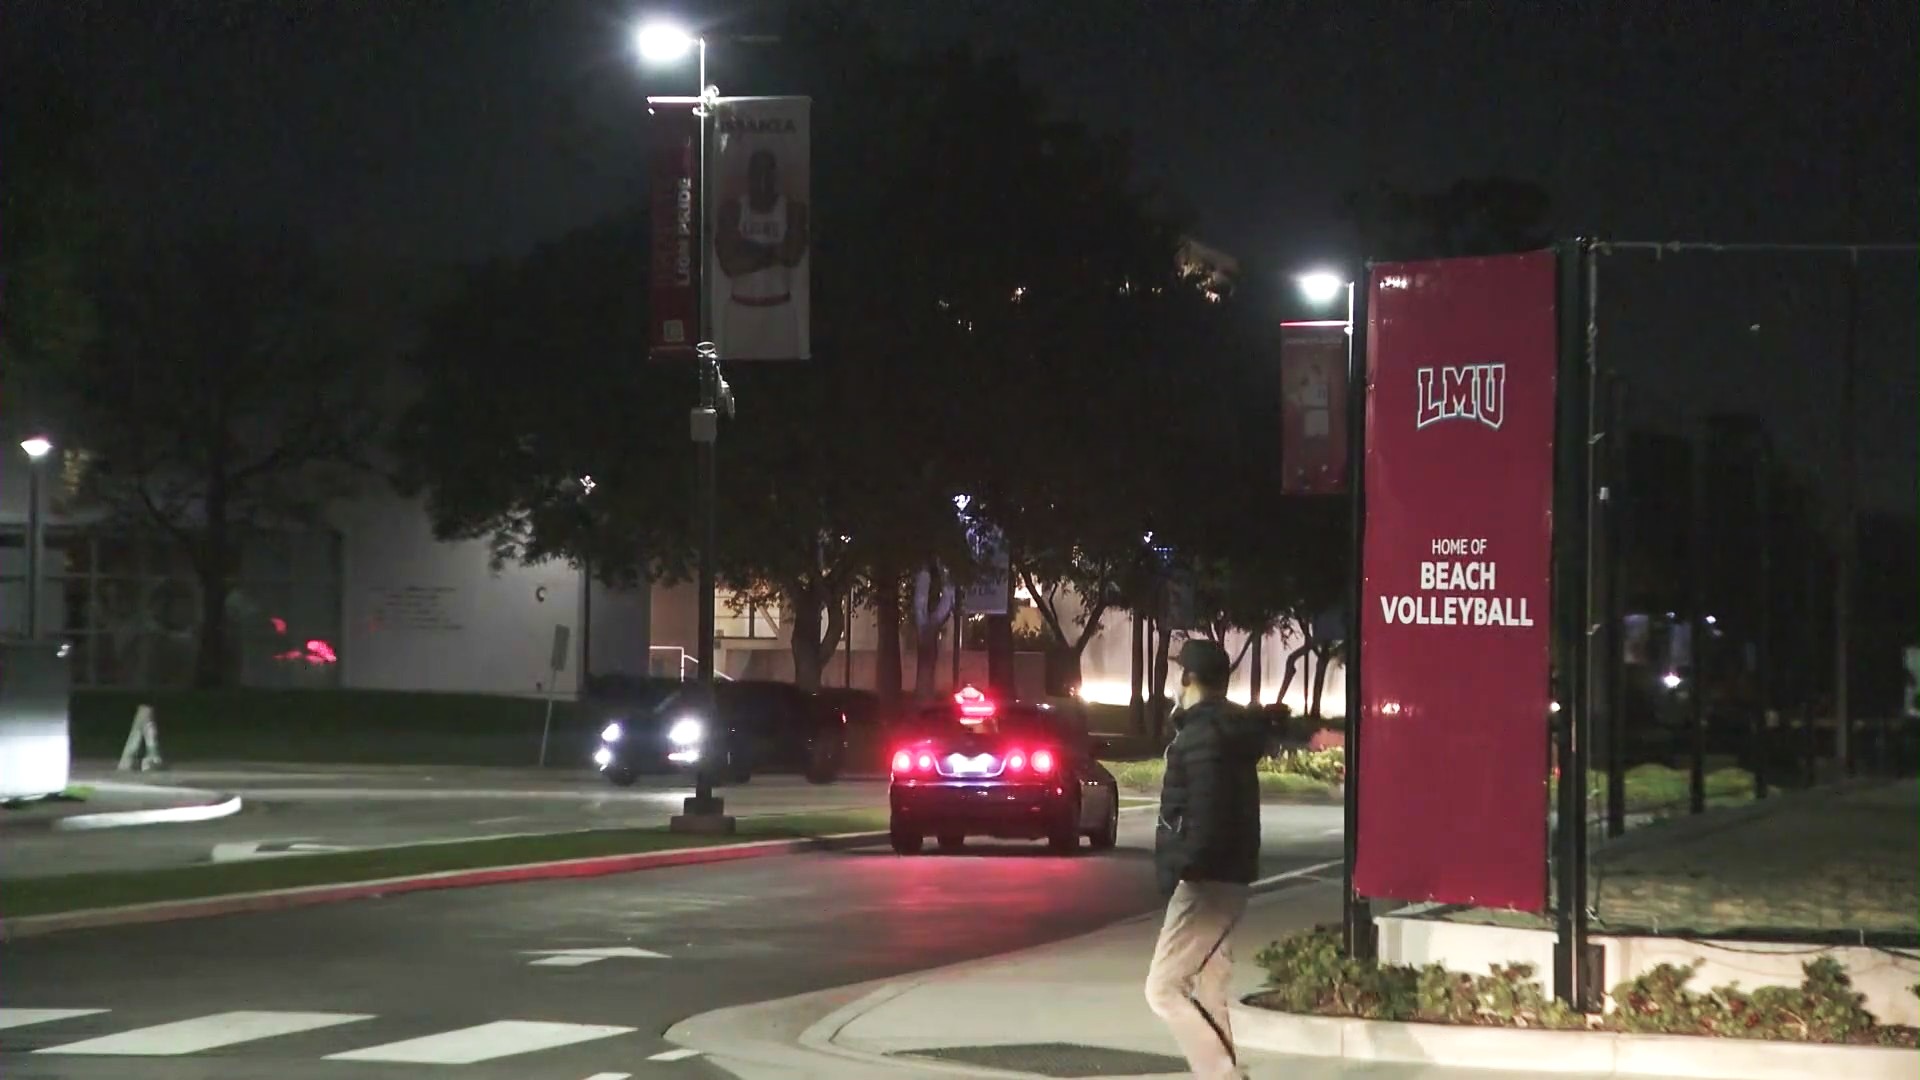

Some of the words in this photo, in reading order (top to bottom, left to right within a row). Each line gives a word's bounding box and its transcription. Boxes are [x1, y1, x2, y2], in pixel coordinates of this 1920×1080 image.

[677, 177, 692, 236] PRIDE
[1416, 362, 1506, 430] LMU
[1431, 538, 1468, 555] HOME
[1470, 538, 1488, 555] OF
[1420, 561, 1496, 590] BEACH
[1380, 596, 1534, 627] VOLLEYBALL
